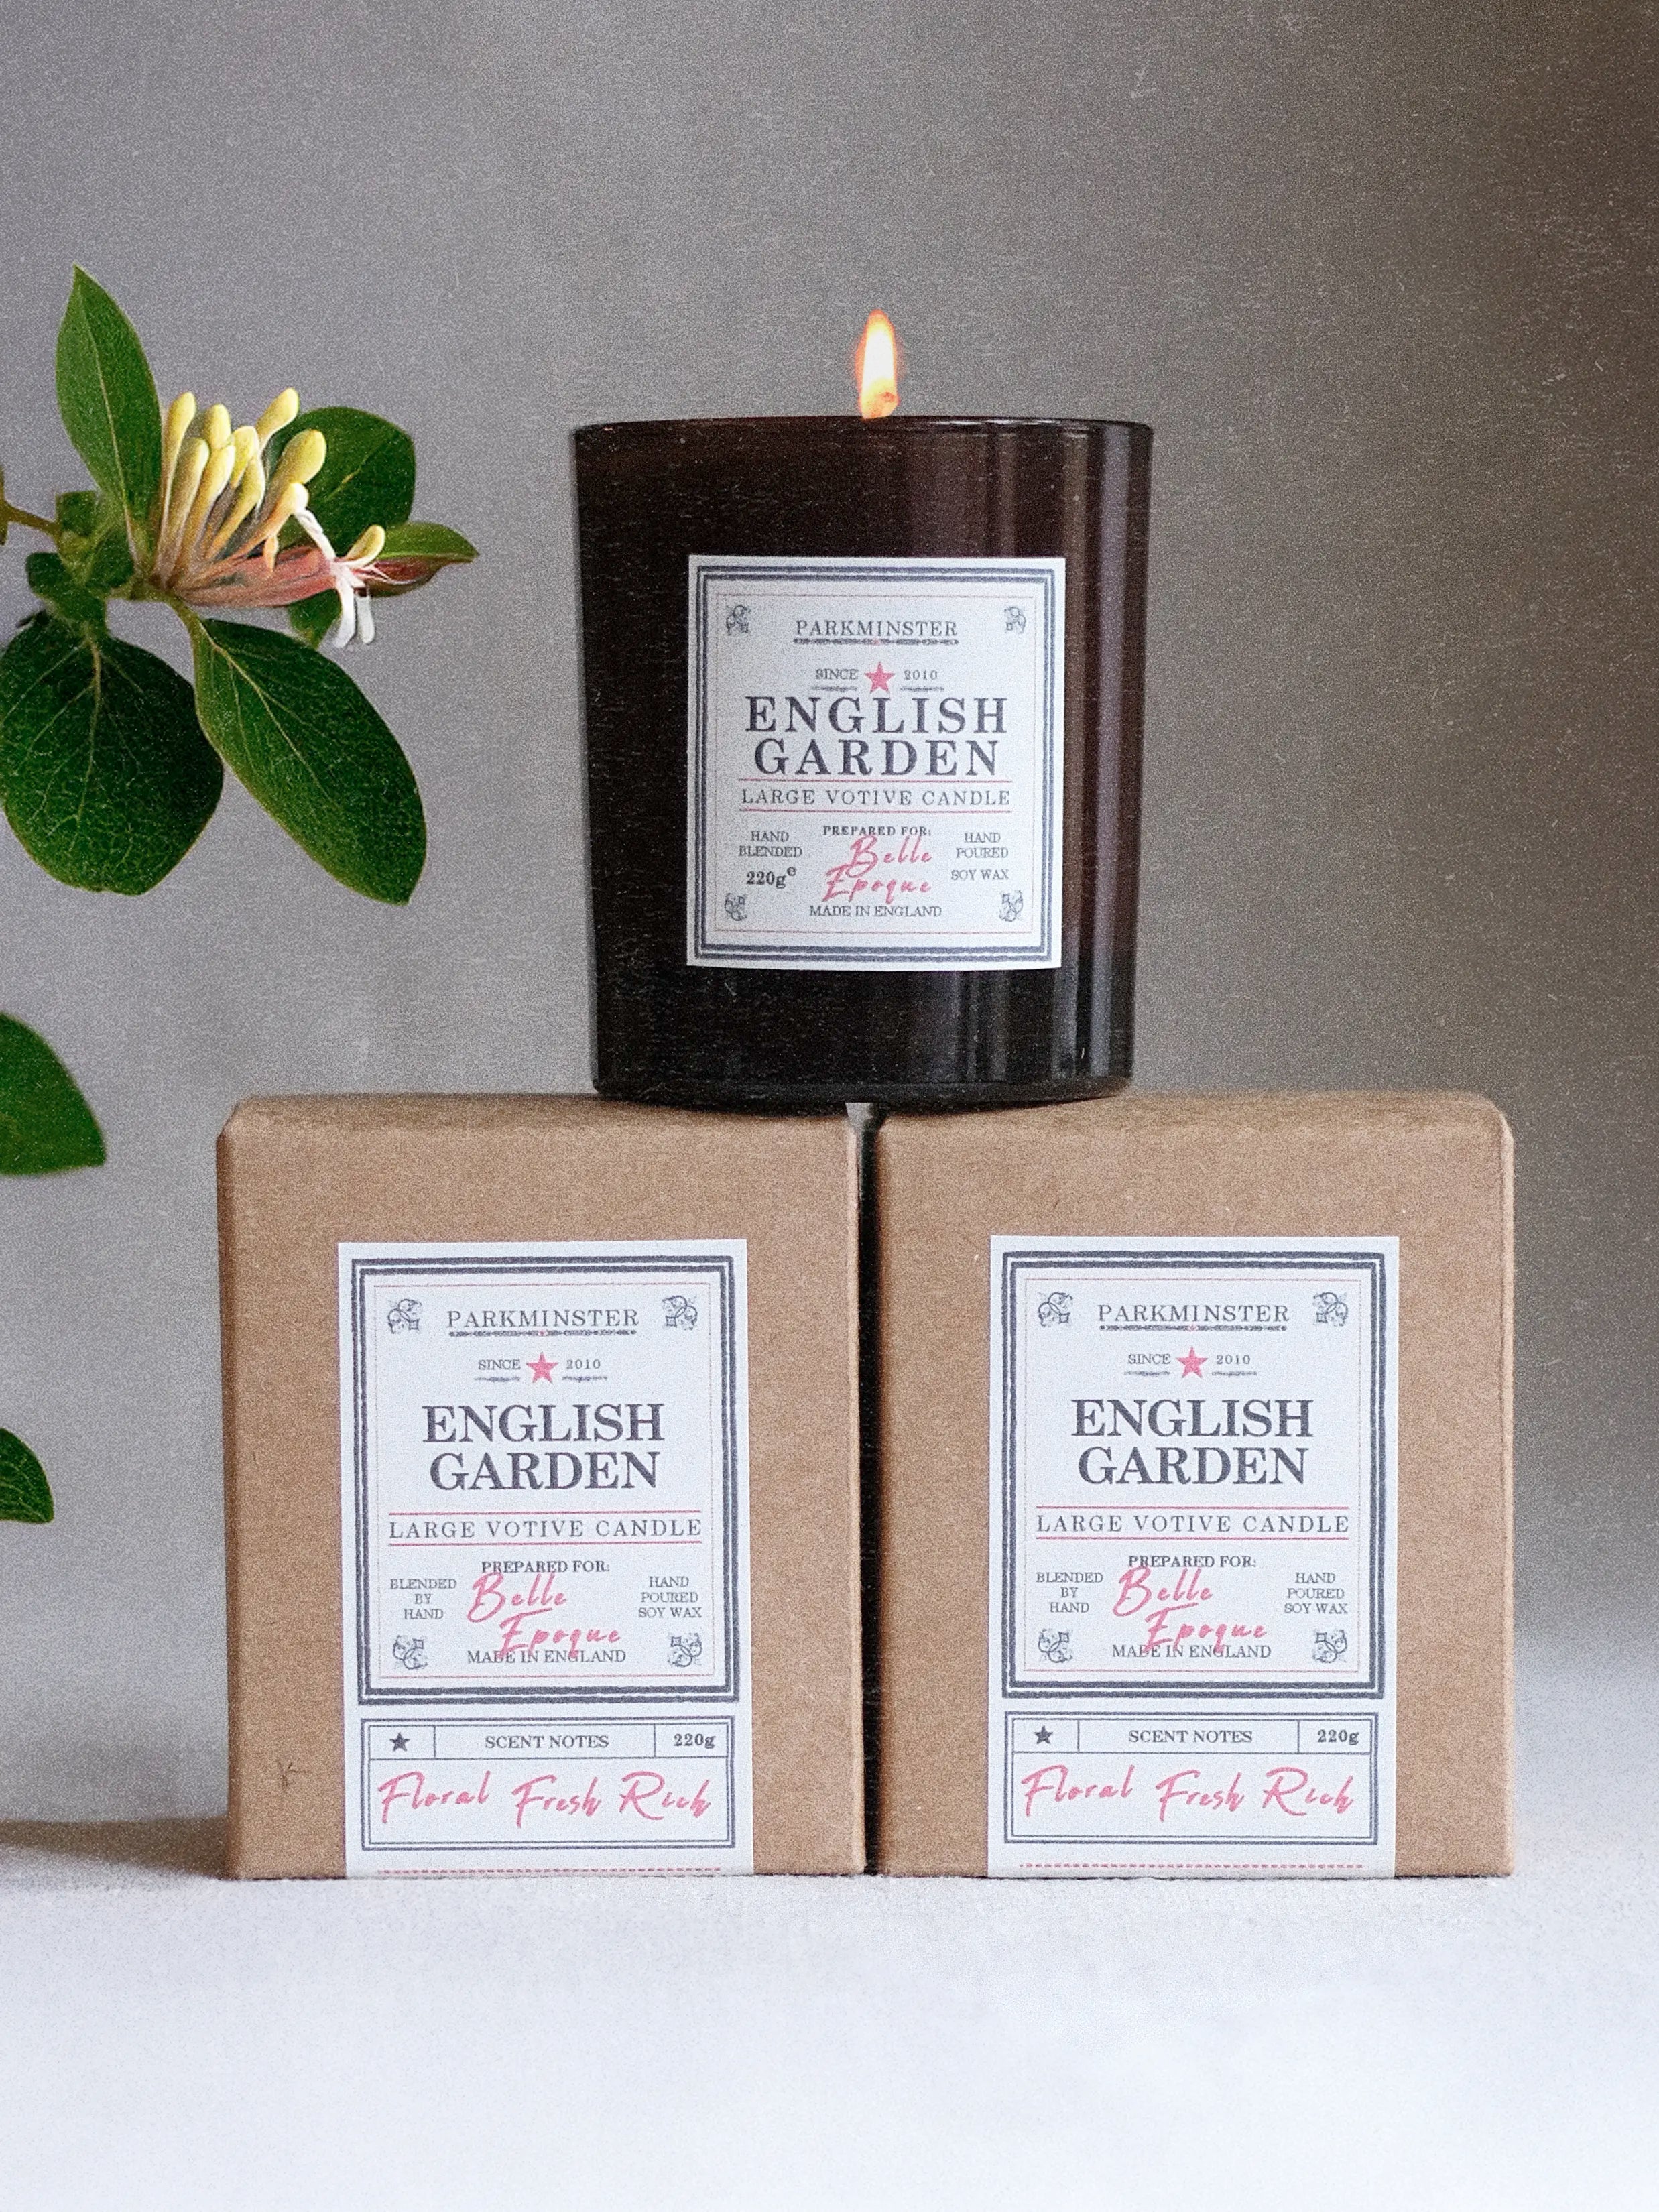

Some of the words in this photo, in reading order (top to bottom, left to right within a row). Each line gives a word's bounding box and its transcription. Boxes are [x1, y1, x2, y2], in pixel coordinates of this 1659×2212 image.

[796, 620, 959, 638] PARKMINSTER
[815, 669, 859, 680] SINCE
[904, 670, 938, 681] 2010
[745, 696, 1007, 735] ENGLISH
[753, 738, 999, 776] GARDEN
[741, 790, 816, 805] LARGE
[826, 790, 912, 805] VOTIVE
[922, 791, 1010, 806] CANDLE
[751, 831, 789, 842] HAND
[823, 826, 896, 836] PREPARED
[901, 826, 931, 837] FOR:
[964, 833, 1001, 843] HAND
[739, 846, 802, 857] BLENDED
[846, 836, 932, 877] Belle
[957, 847, 1008, 858] POURED
[950, 870, 976, 880] SOY
[981, 869, 1009, 880] WAX
[810, 906, 851, 916] MADE
[855, 906, 870, 916] IN
[874, 906, 942, 917] ENGLAND
[446, 1310, 639, 1329] PARKMINSTER
[1097, 1304, 1290, 1323] PARKMINSTER
[477, 1359, 521, 1371] SINCE
[566, 1359, 601, 1370] 2010
[1127, 1353, 1171, 1365] SINCE
[1216, 1354, 1251, 1365] 2010
[422, 1403, 666, 1443] ENGLISH
[1071, 1398, 1314, 1438] ENGLISH
[430, 1451, 660, 1491] GARDEN
[1077, 1446, 1310, 1485] GARDEN
[389, 1522, 475, 1539] LARGE
[487, 1520, 583, 1538] VOTIVE
[595, 1519, 702, 1537] CANDLE
[1036, 1516, 1122, 1534] LARGE
[1134, 1516, 1231, 1533] VOTIVE
[1243, 1515, 1350, 1534] CANDLE
[481, 1561, 568, 1575] PREPARED
[573, 1560, 611, 1573] FOR:
[1128, 1555, 1215, 1569] PREPARED
[1220, 1555, 1257, 1569] FOR:
[389, 1579, 457, 1590] BLENDED
[649, 1577, 689, 1588] HAND
[1036, 1572, 1103, 1583] BLENDED
[1295, 1573, 1336, 1583] HAND
[467, 1571, 567, 1623] Belle
[641, 1592, 698, 1603] POURED
[1060, 1587, 1078, 1599] BY
[1113, 1566, 1213, 1617] Belle
[1287, 1588, 1345, 1599] POURED
[414, 1593, 431, 1605] BY
[404, 1609, 444, 1621] HAND
[638, 1607, 666, 1619] SOY
[670, 1607, 702, 1619] WAX
[1050, 1602, 1090, 1614] HAND
[1284, 1603, 1311, 1615] SOY
[1315, 1603, 1349, 1615] WAX
[467, 1651, 515, 1664] MADE
[520, 1650, 538, 1664] IN
[544, 1649, 627, 1664] ENGLAND
[1112, 1645, 1162, 1658] MADE
[1166, 1645, 1184, 1658] IN
[1189, 1644, 1272, 1658] ENGLAND
[485, 1735, 546, 1749] SCENT
[548, 1734, 609, 1749] NOTES
[673, 1733, 717, 1749] 220g
[1128, 1730, 1188, 1744] SCENT
[1192, 1730, 1253, 1744] NOTES
[1317, 1730, 1359, 1746] 220g
[378, 1770, 491, 1825] Floral
[511, 1774, 603, 1829] Fresh
[620, 1770, 711, 1820] Rich
[1021, 1764, 1135, 1817] Floral
[1155, 1769, 1245, 1822] Fresh
[1263, 1767, 1354, 1817] Rich
